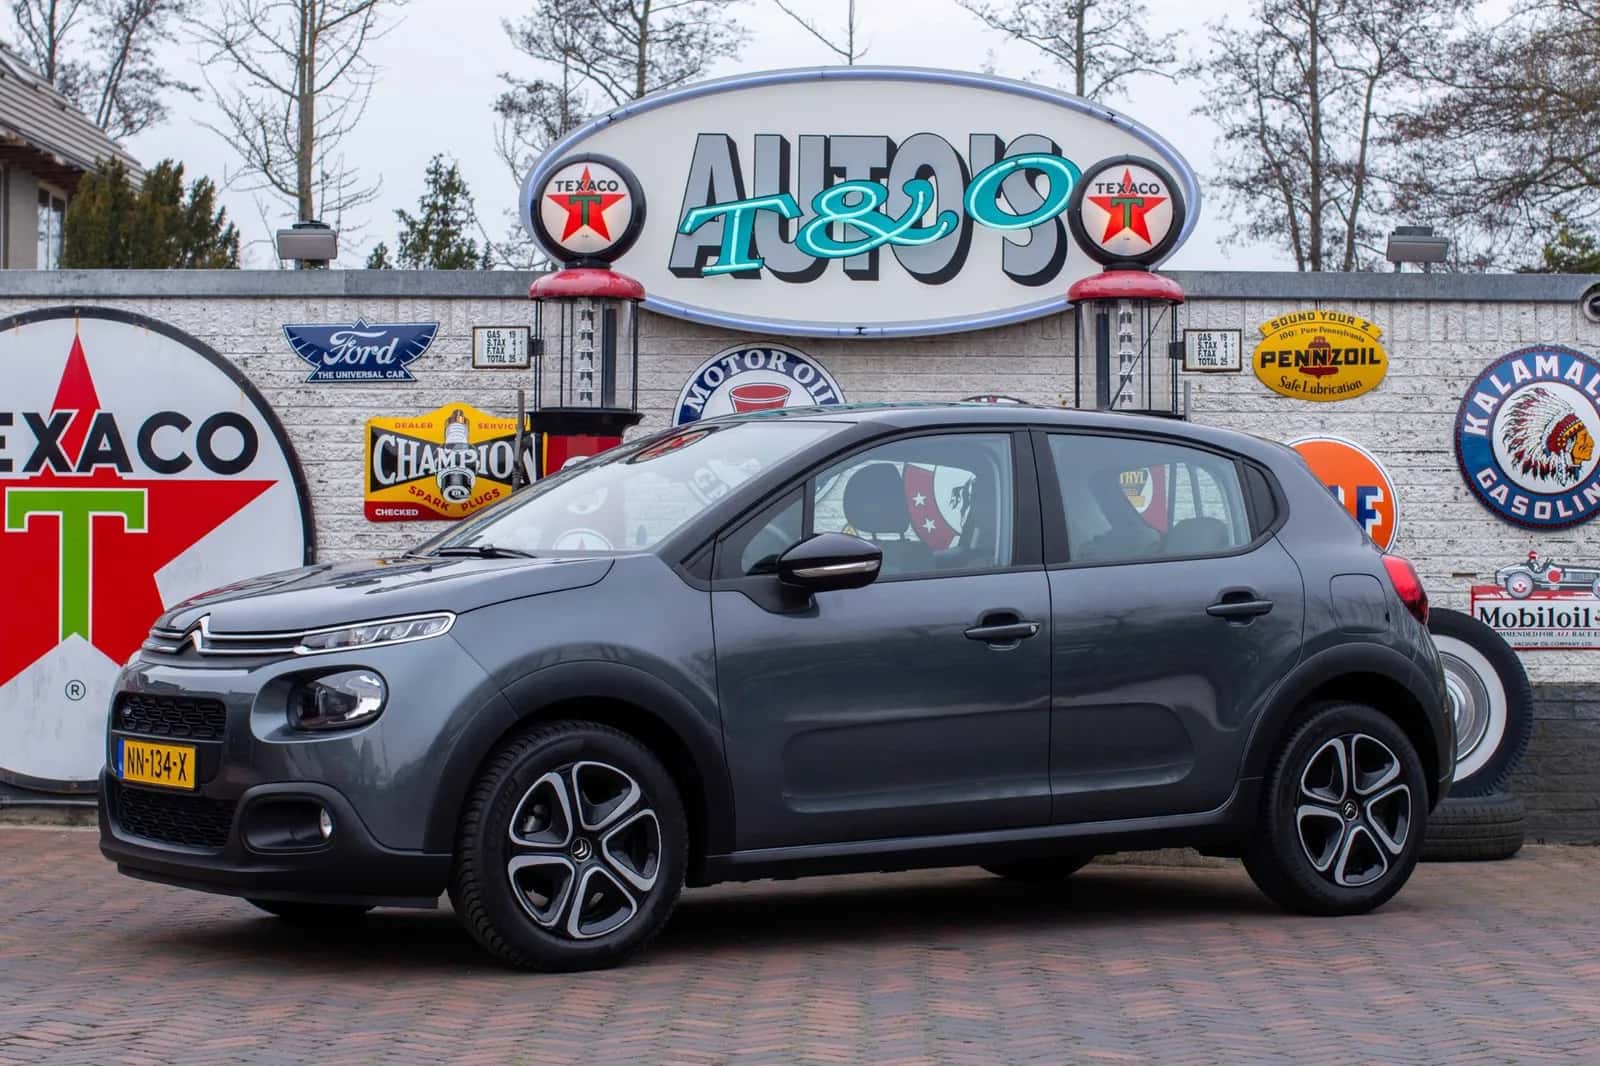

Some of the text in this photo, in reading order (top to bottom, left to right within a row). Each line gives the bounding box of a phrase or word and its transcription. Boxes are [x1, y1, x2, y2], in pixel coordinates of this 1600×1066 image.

[555, 180, 619, 192] TEXACO
[1095, 183, 1161, 194] TEXACO
[669, 132, 1067, 286] AUTO'S
[1271, 311, 1371, 331] SOUND YOUR Z
[487, 331, 501, 339] GAS
[1198, 333, 1212, 341] GAS
[323, 331, 399, 365] Ford
[1261, 347, 1382, 368] PENNZOIL
[487, 355, 507, 363] TOTAL
[1198, 358, 1218, 366] TOTAL
[318, 370, 405, 379] THE UNIVERSAL CAR
[684, 349, 787, 414] MOTOR
[1278, 375, 1363, 395] Safe Lubrication
[1464, 355, 1600, 437] KALAMAL
[478, 422, 520, 430] SERVIC
[408, 485, 501, 511] SPARK PLUGS
[1476, 467, 1600, 519] GASOLIN
[1480, 607, 1591, 628] Mobiloil
[127, 747, 188, 782] NN-134-X
